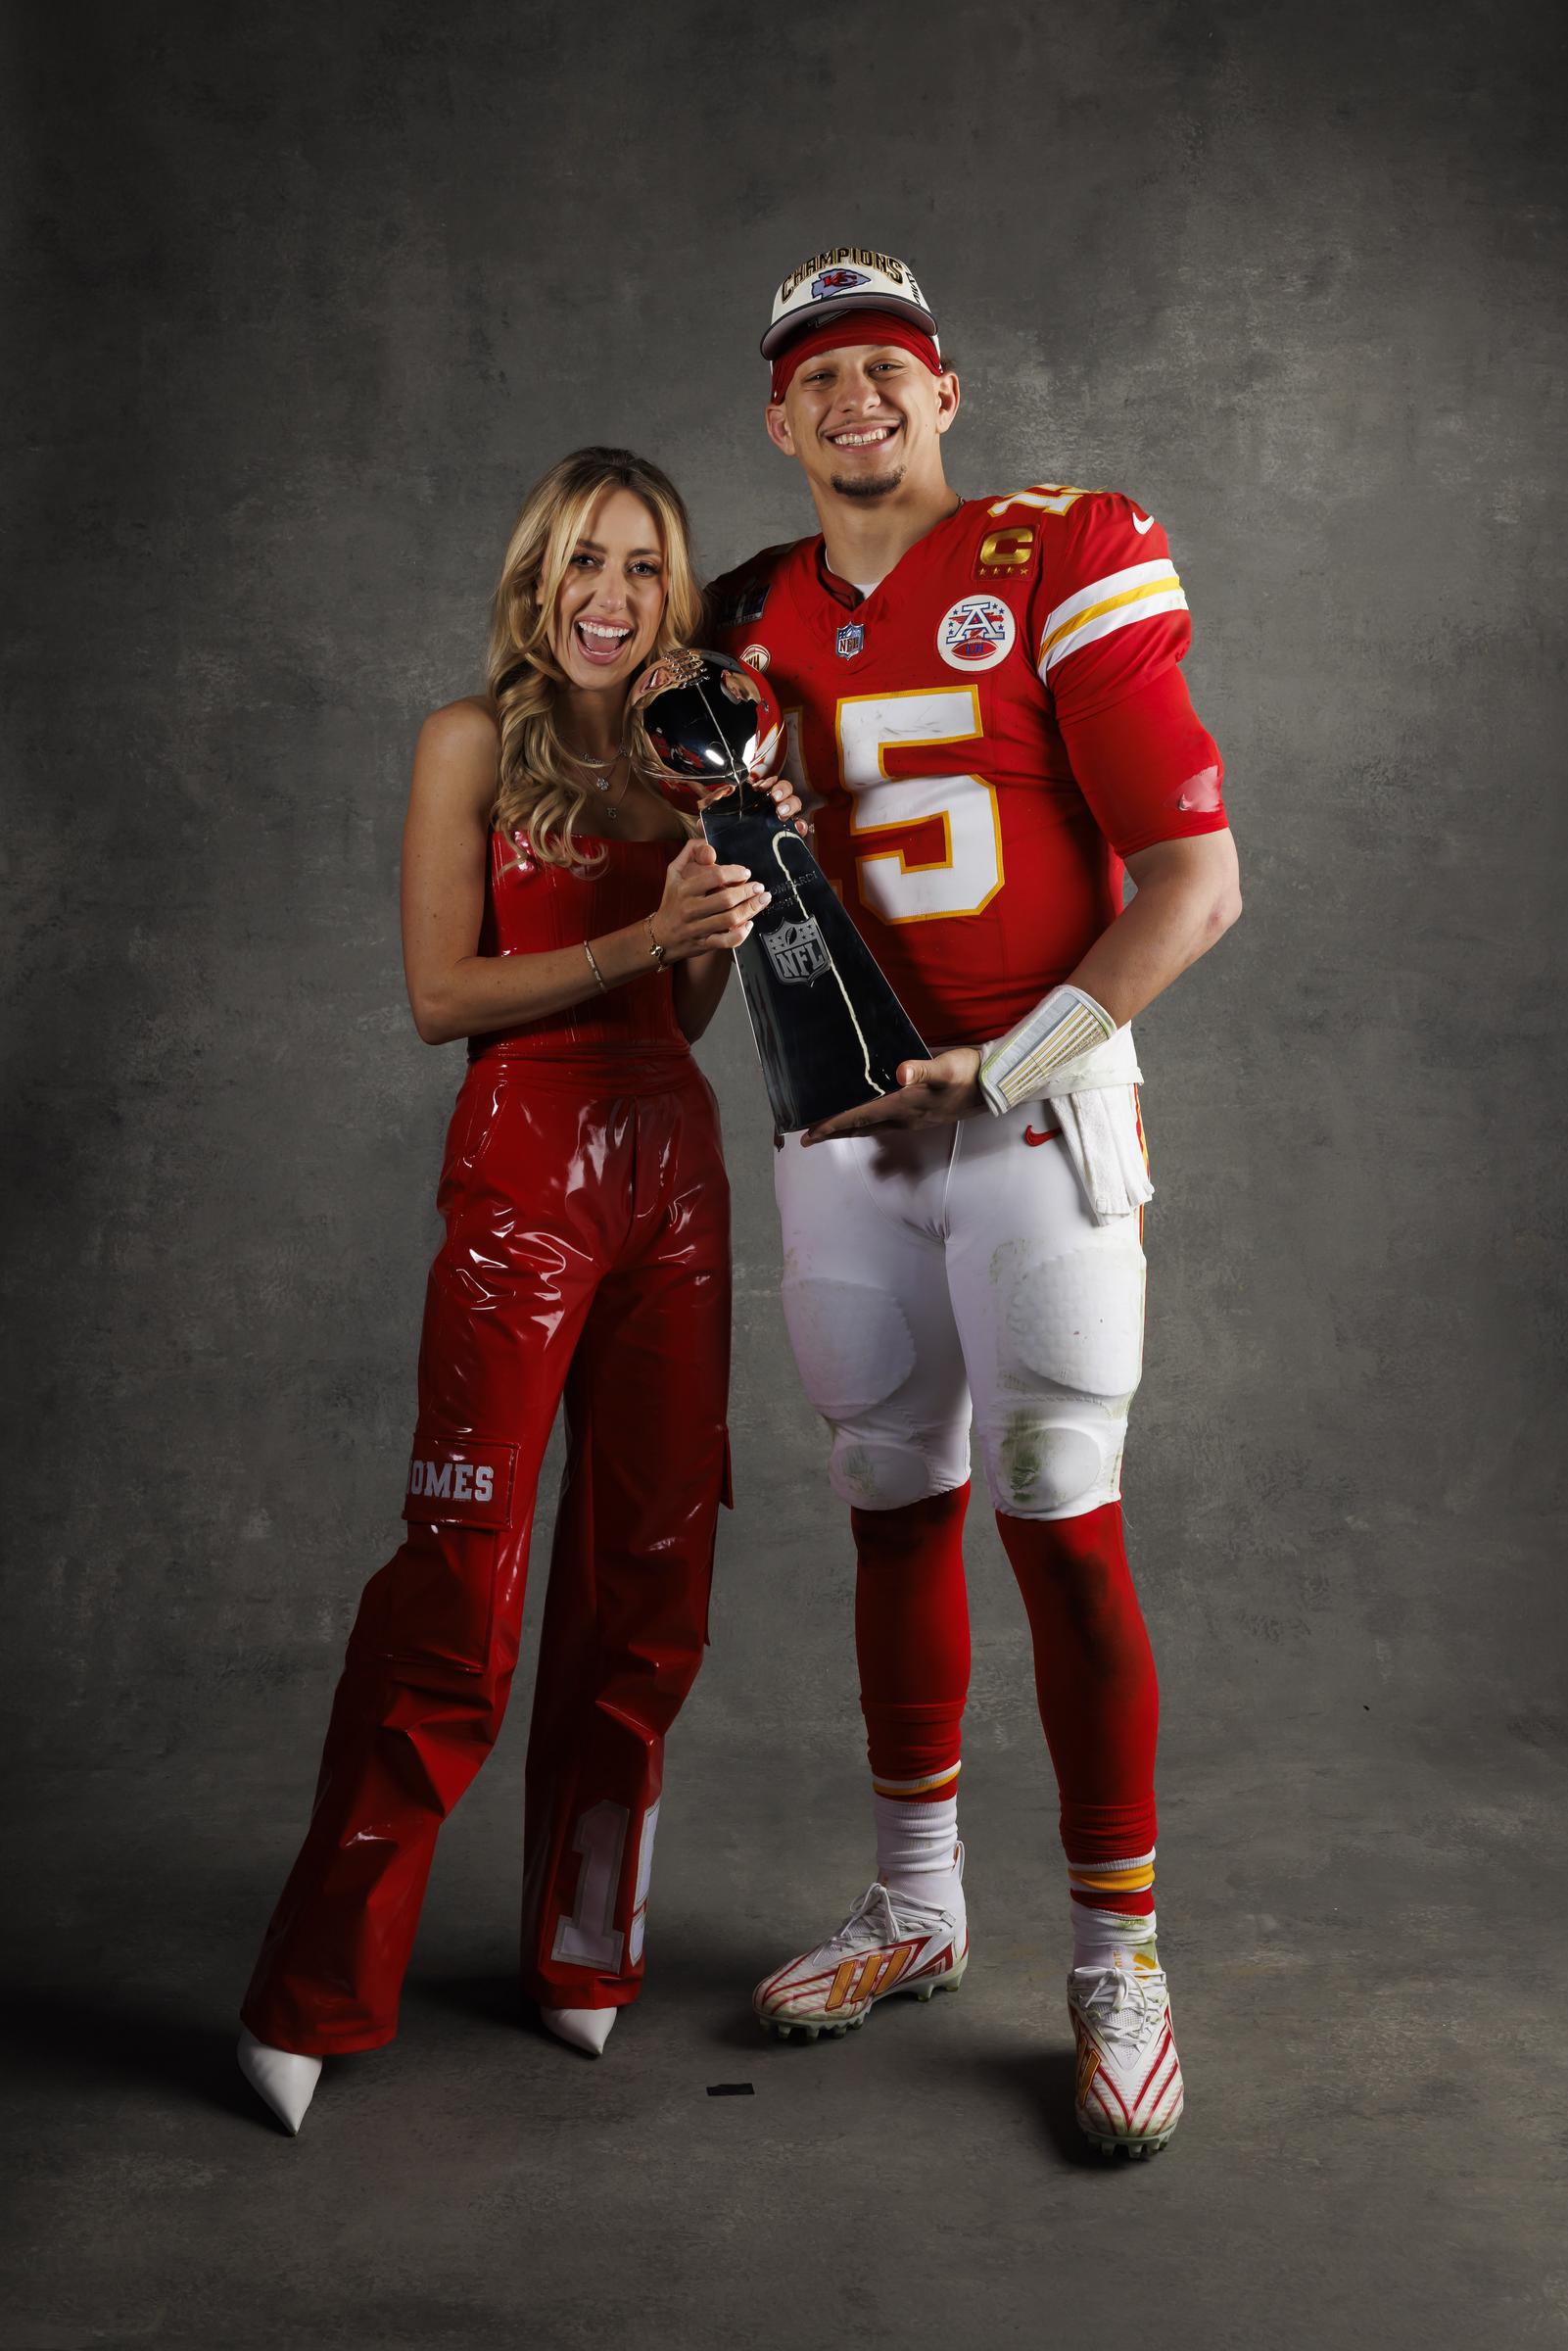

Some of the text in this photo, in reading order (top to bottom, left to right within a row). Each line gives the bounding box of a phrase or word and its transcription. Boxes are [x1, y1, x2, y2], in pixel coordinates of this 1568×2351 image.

[782, 248, 903, 304] CHAMPIONS
[980, 527, 1033, 565] C
[772, 870, 817, 895] OMBARDI
[776, 942, 826, 978] NFL
[407, 1459, 495, 1502] OMES
